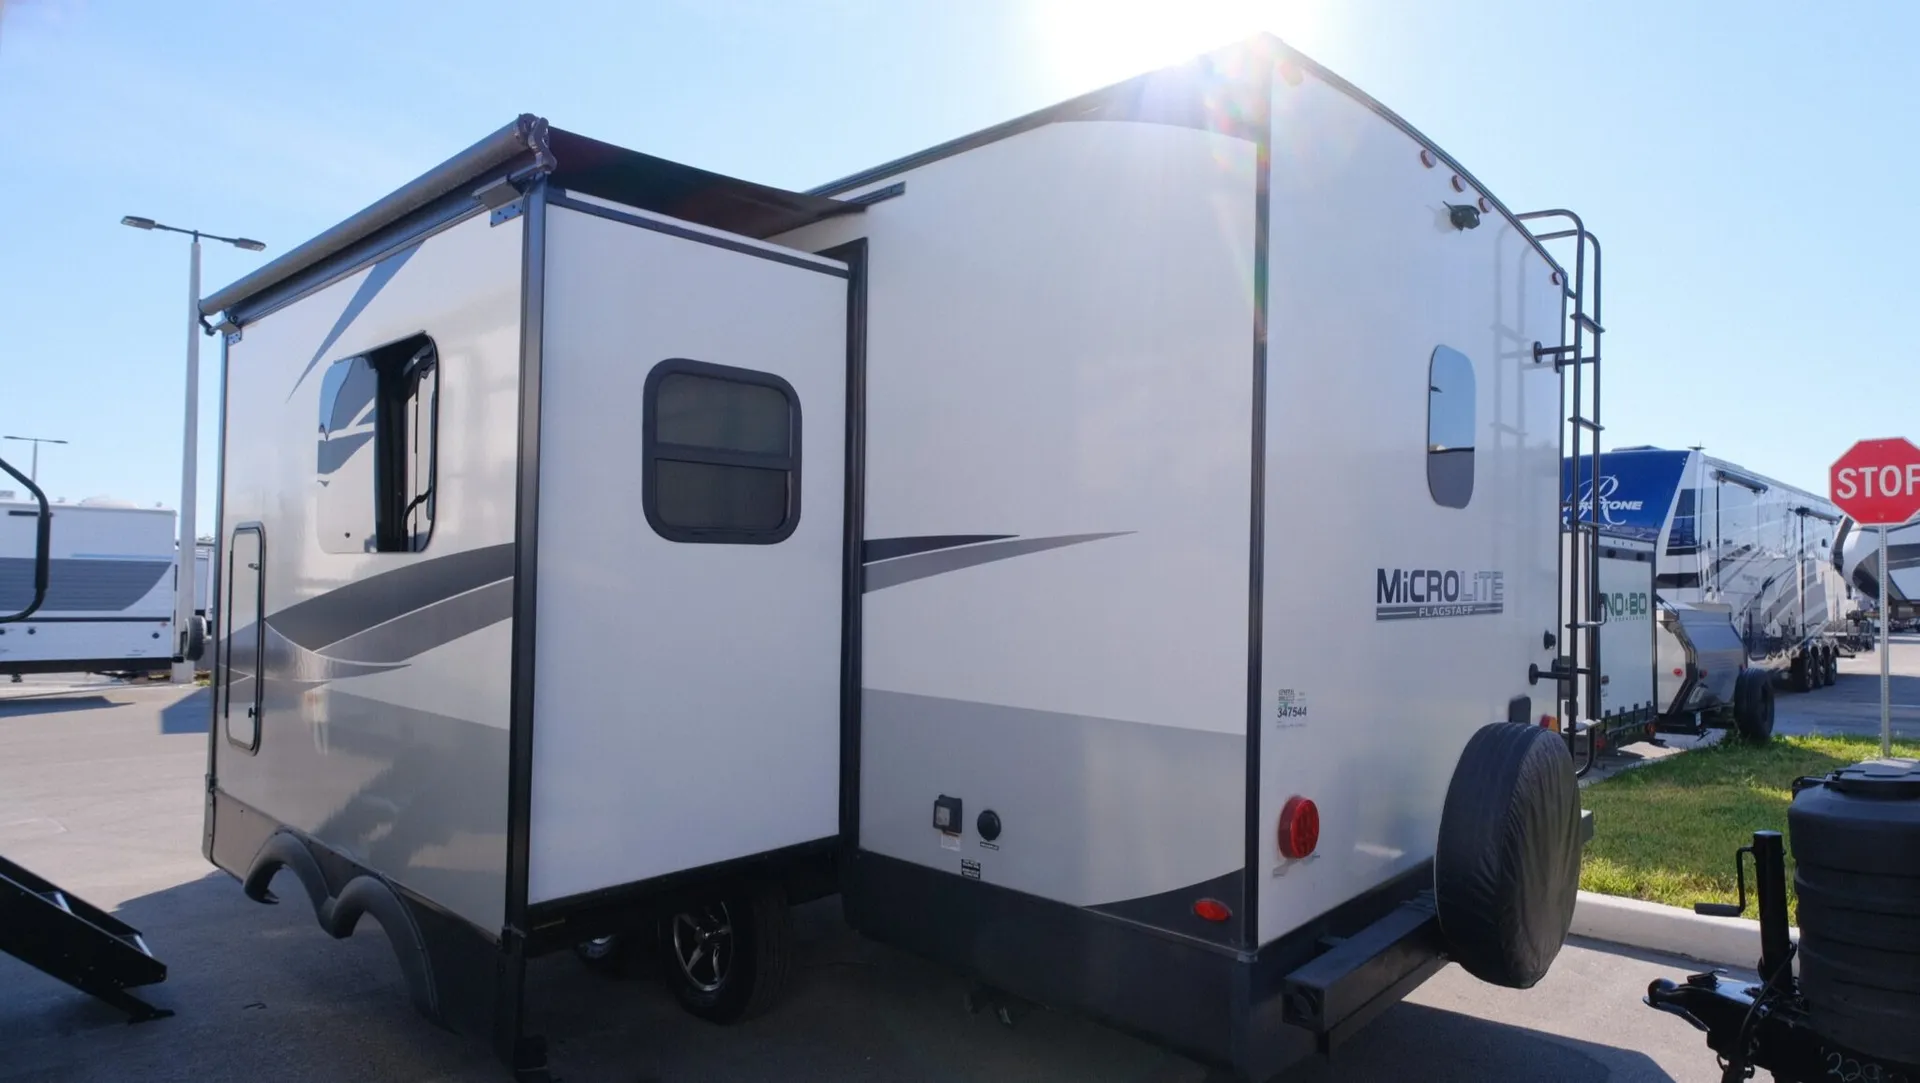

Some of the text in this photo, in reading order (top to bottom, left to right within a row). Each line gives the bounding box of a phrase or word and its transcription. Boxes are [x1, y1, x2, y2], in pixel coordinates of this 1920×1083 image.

[1837, 464, 1920, 499] STOP
[1419, 605, 1474, 617] FLAGSTAFF
[1277, 706, 1307, 718] 347544
